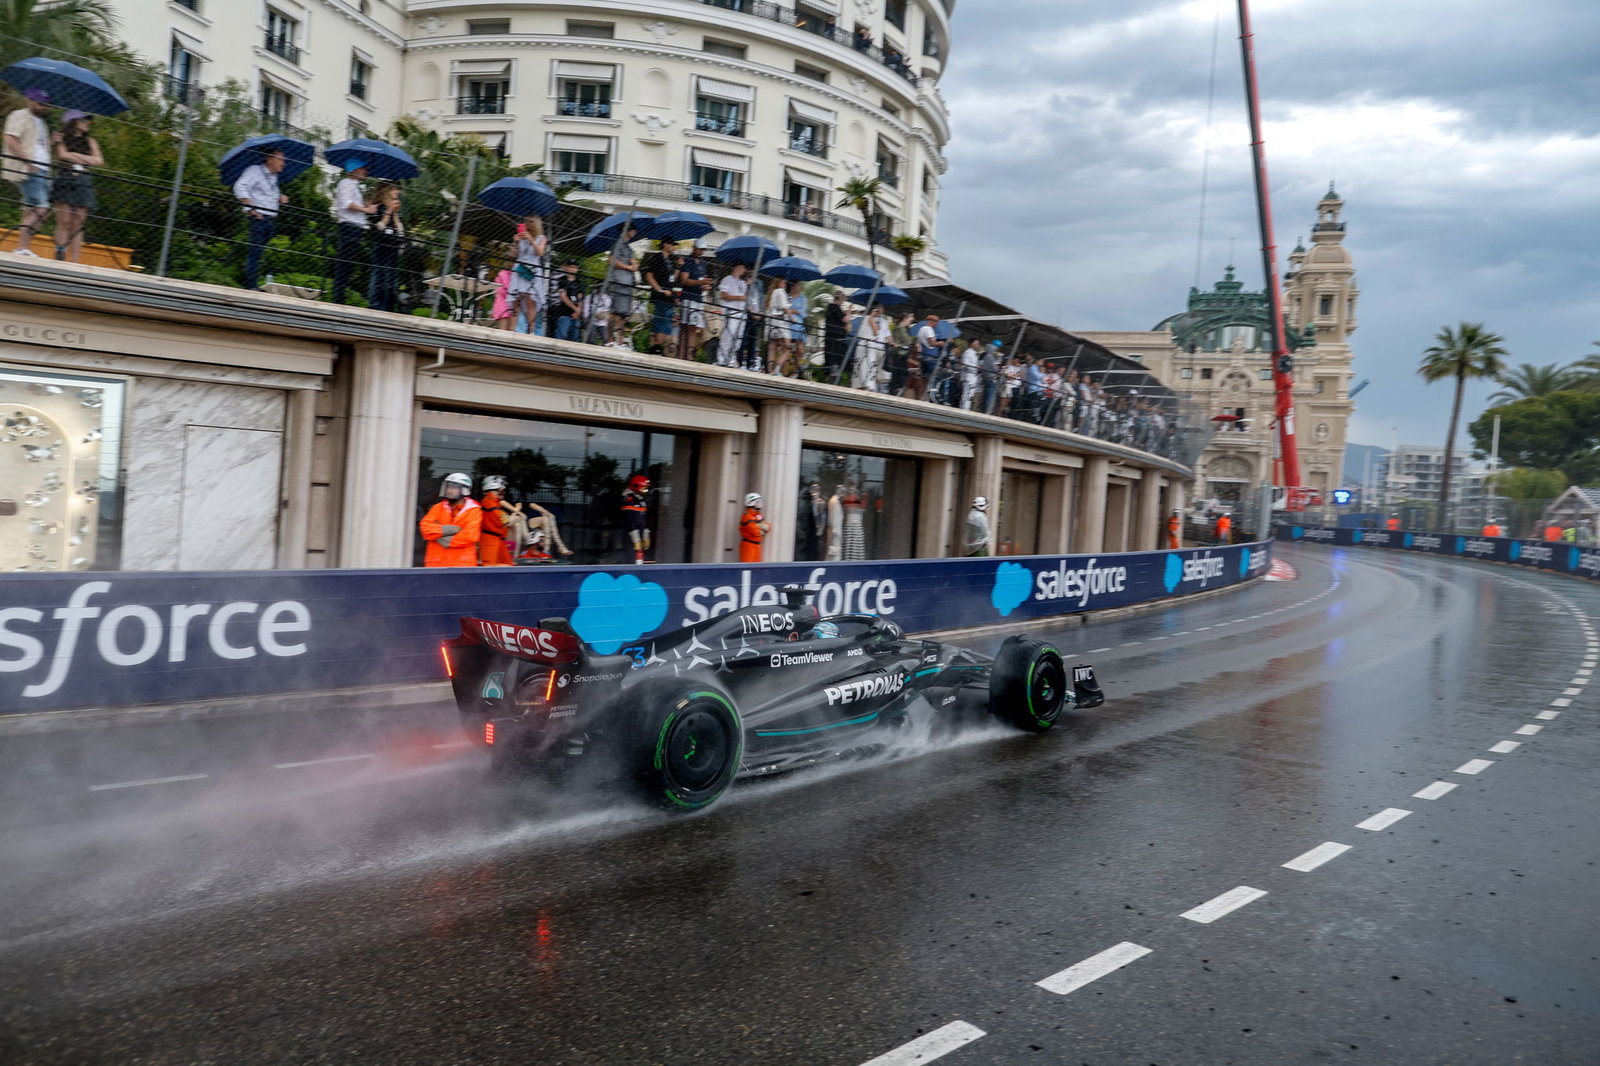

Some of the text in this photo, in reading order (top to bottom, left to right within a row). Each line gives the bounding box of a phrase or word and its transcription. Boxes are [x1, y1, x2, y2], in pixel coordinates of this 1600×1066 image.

[3, 325, 86, 345] GUCCI
[569, 396, 644, 418] VALENTINO
[1035, 558, 1127, 607] salesforce
[739, 612, 795, 635] INEOS
[480, 621, 559, 658] INEOS
[781, 652, 834, 666] TeamViewer
[1074, 667, 1093, 682] IWC
[824, 673, 904, 705] PETRONAS
